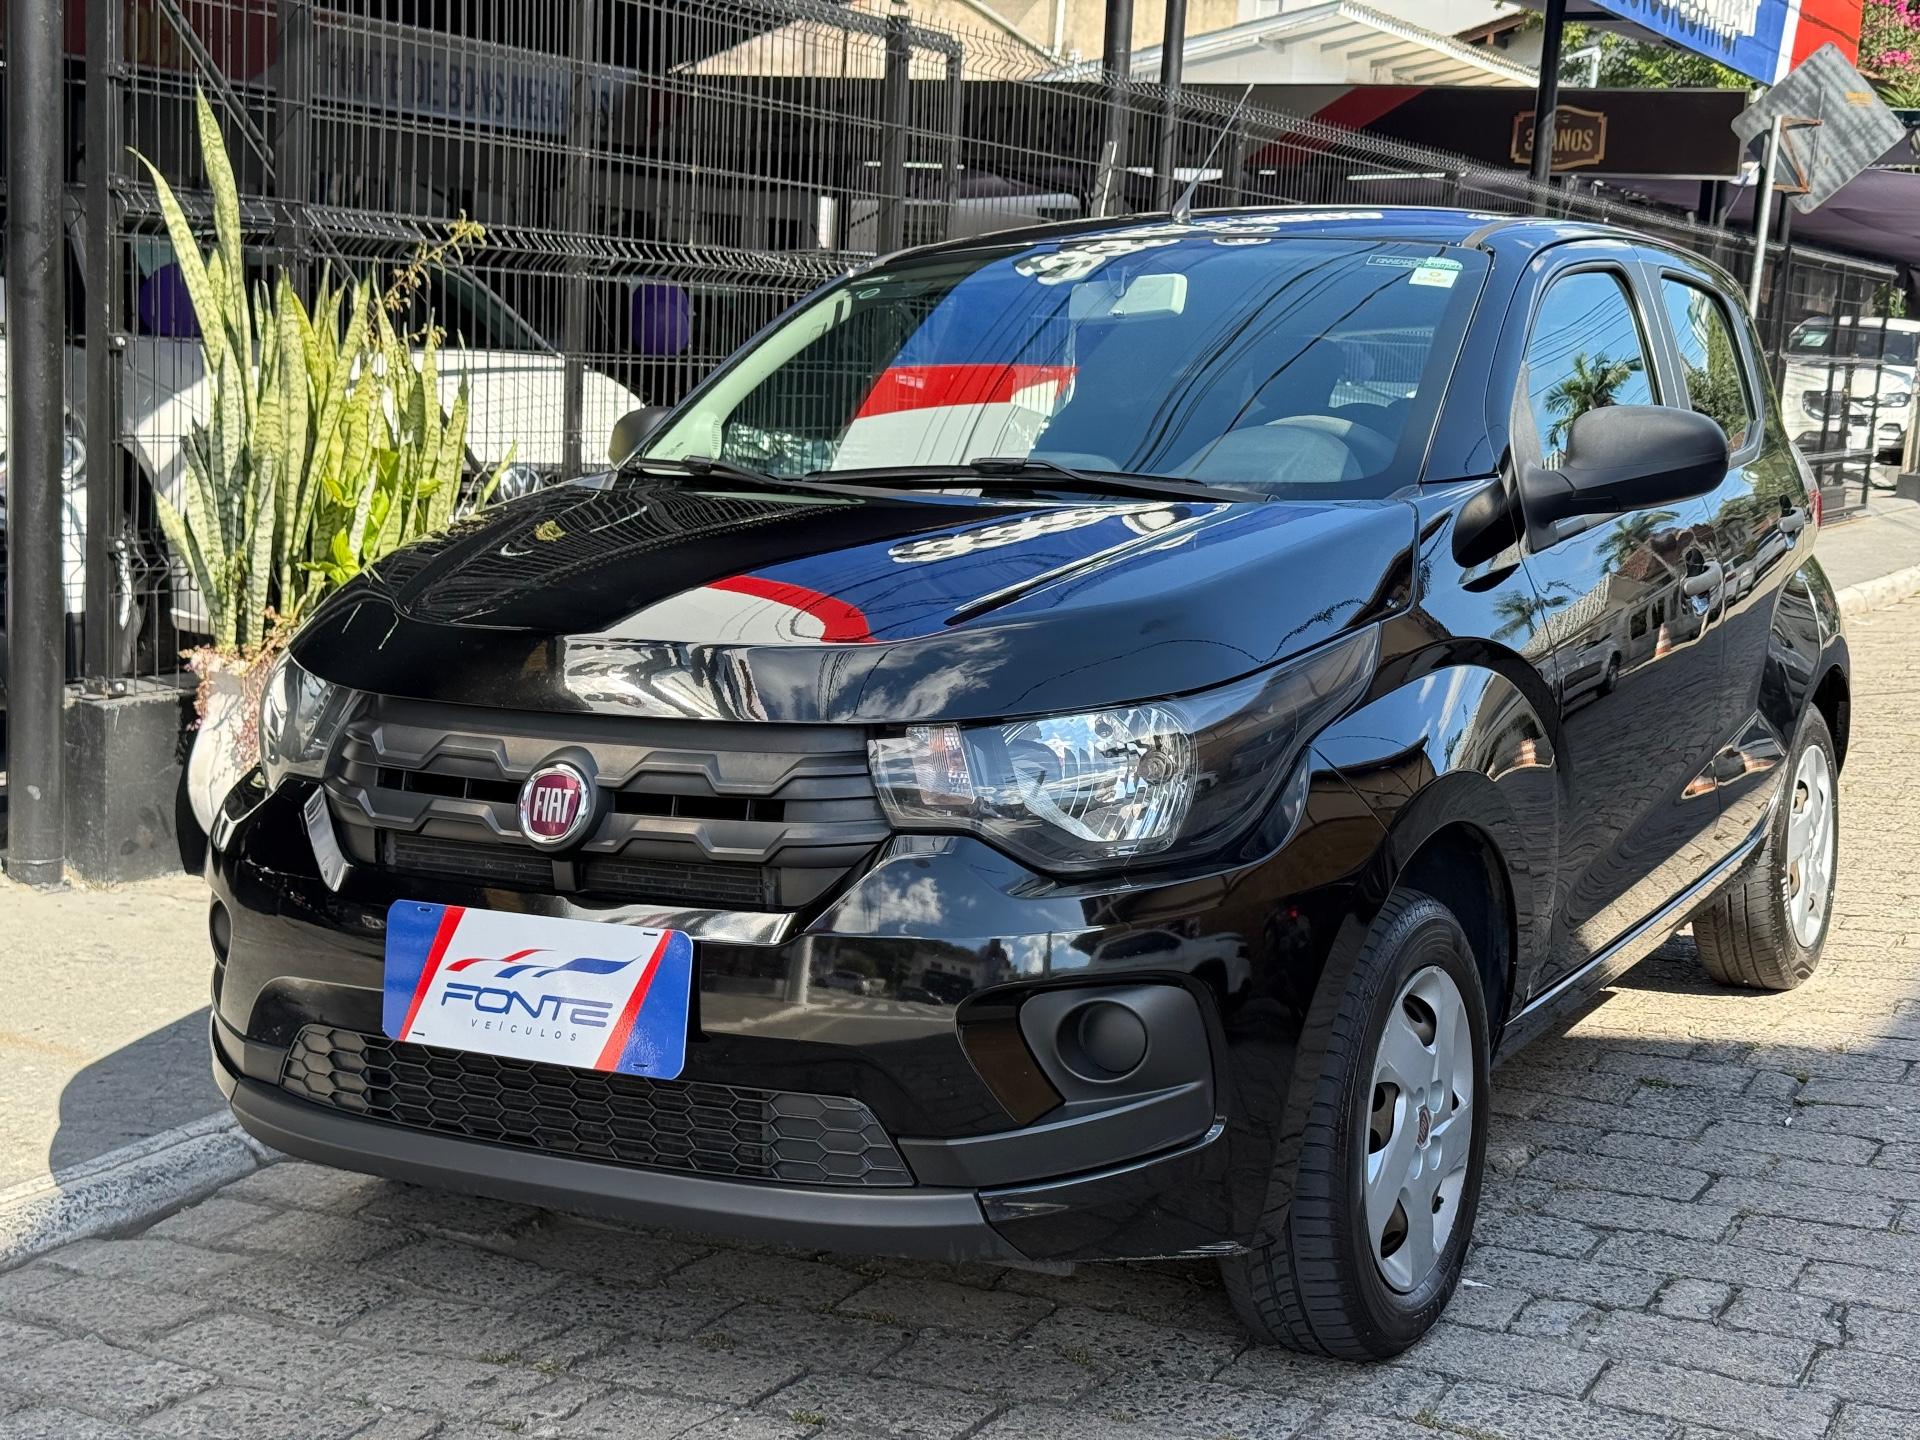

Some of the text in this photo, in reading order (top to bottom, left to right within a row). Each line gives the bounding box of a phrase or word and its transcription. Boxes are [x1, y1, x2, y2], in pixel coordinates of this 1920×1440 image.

[1551, 128, 1594, 152] ANOS
[532, 786, 575, 824] FIAT
[441, 982, 614, 1028] FONTE
[471, 1018, 577, 1041] VEÍCULOS
